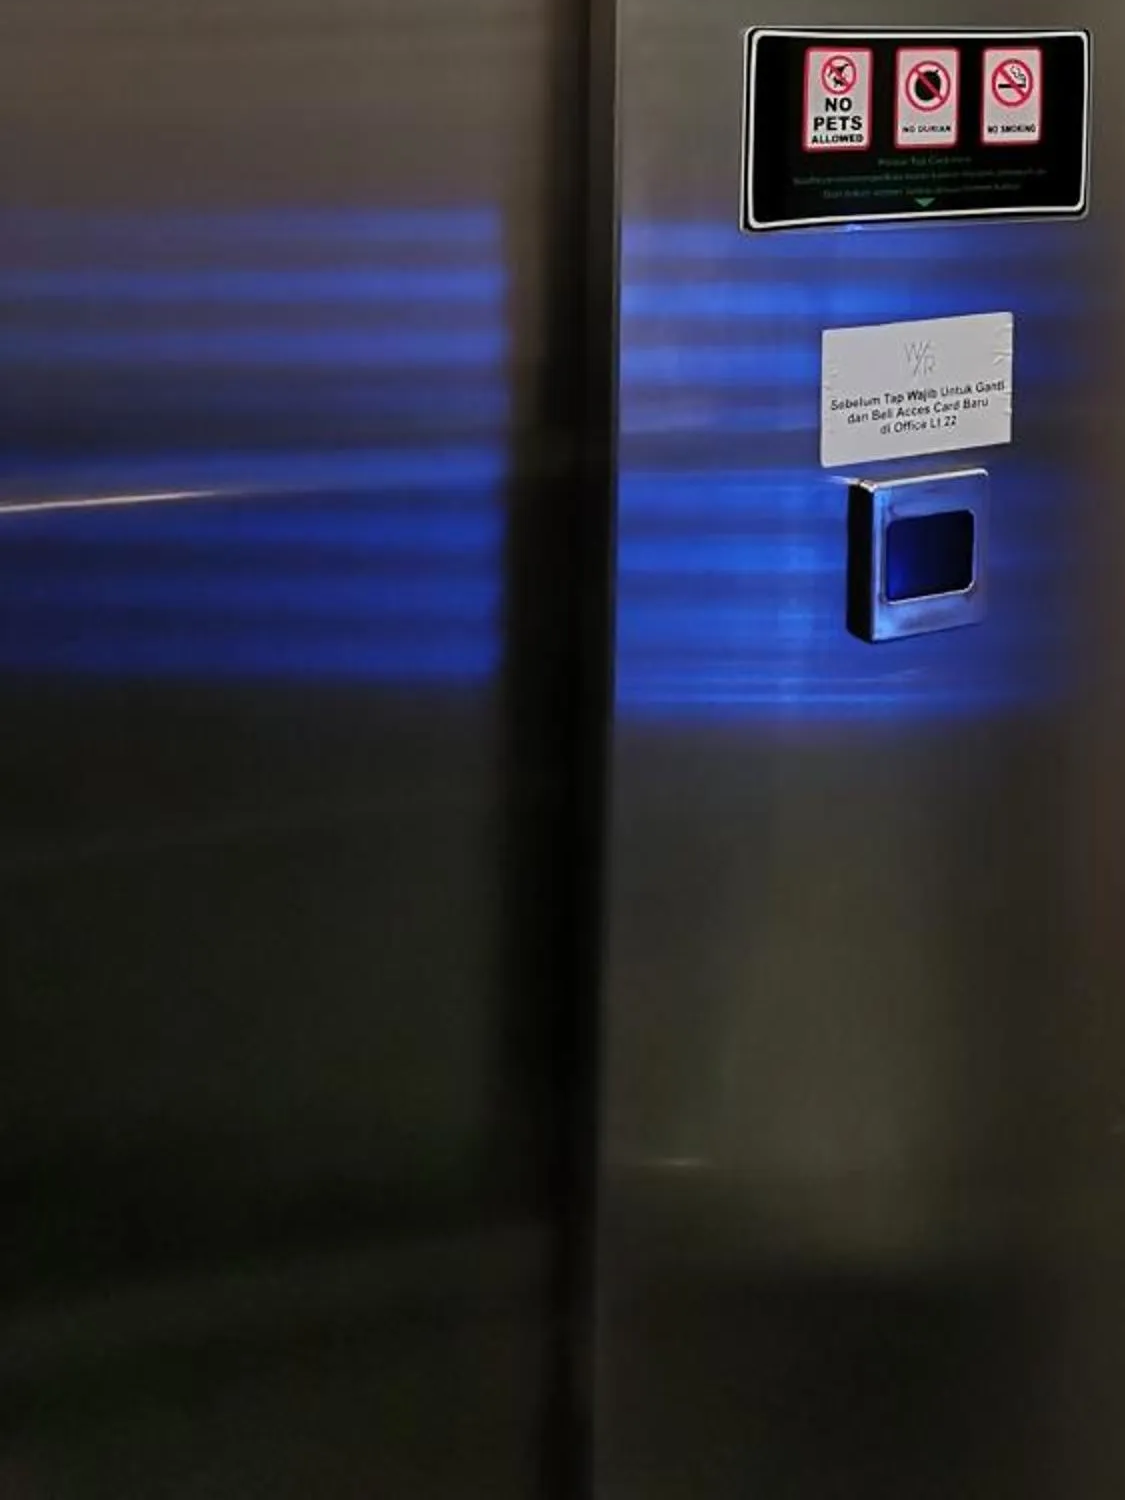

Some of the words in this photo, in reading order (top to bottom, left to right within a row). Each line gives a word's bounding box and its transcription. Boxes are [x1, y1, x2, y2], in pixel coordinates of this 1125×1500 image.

[825, 97, 853, 112] NO
[813, 115, 863, 131] PETS
[1001, 123, 1037, 134] SMOKING
[811, 134, 864, 144] ALLOWED
[831, 396, 881, 412] Sebelum
[884, 392, 905, 407] Tap
[907, 388, 938, 405] Wajib
[940, 384, 973, 398] Untuk
[975, 380, 1005, 394] Ganti
[847, 413, 869, 425] dan
[872, 408, 893, 421] Beli
[896, 404, 931, 418] Acces
[933, 399, 961, 413] Card
[963, 395, 989, 410] Baru
[880, 423, 891, 435] di
[894, 418, 927, 434] Office
